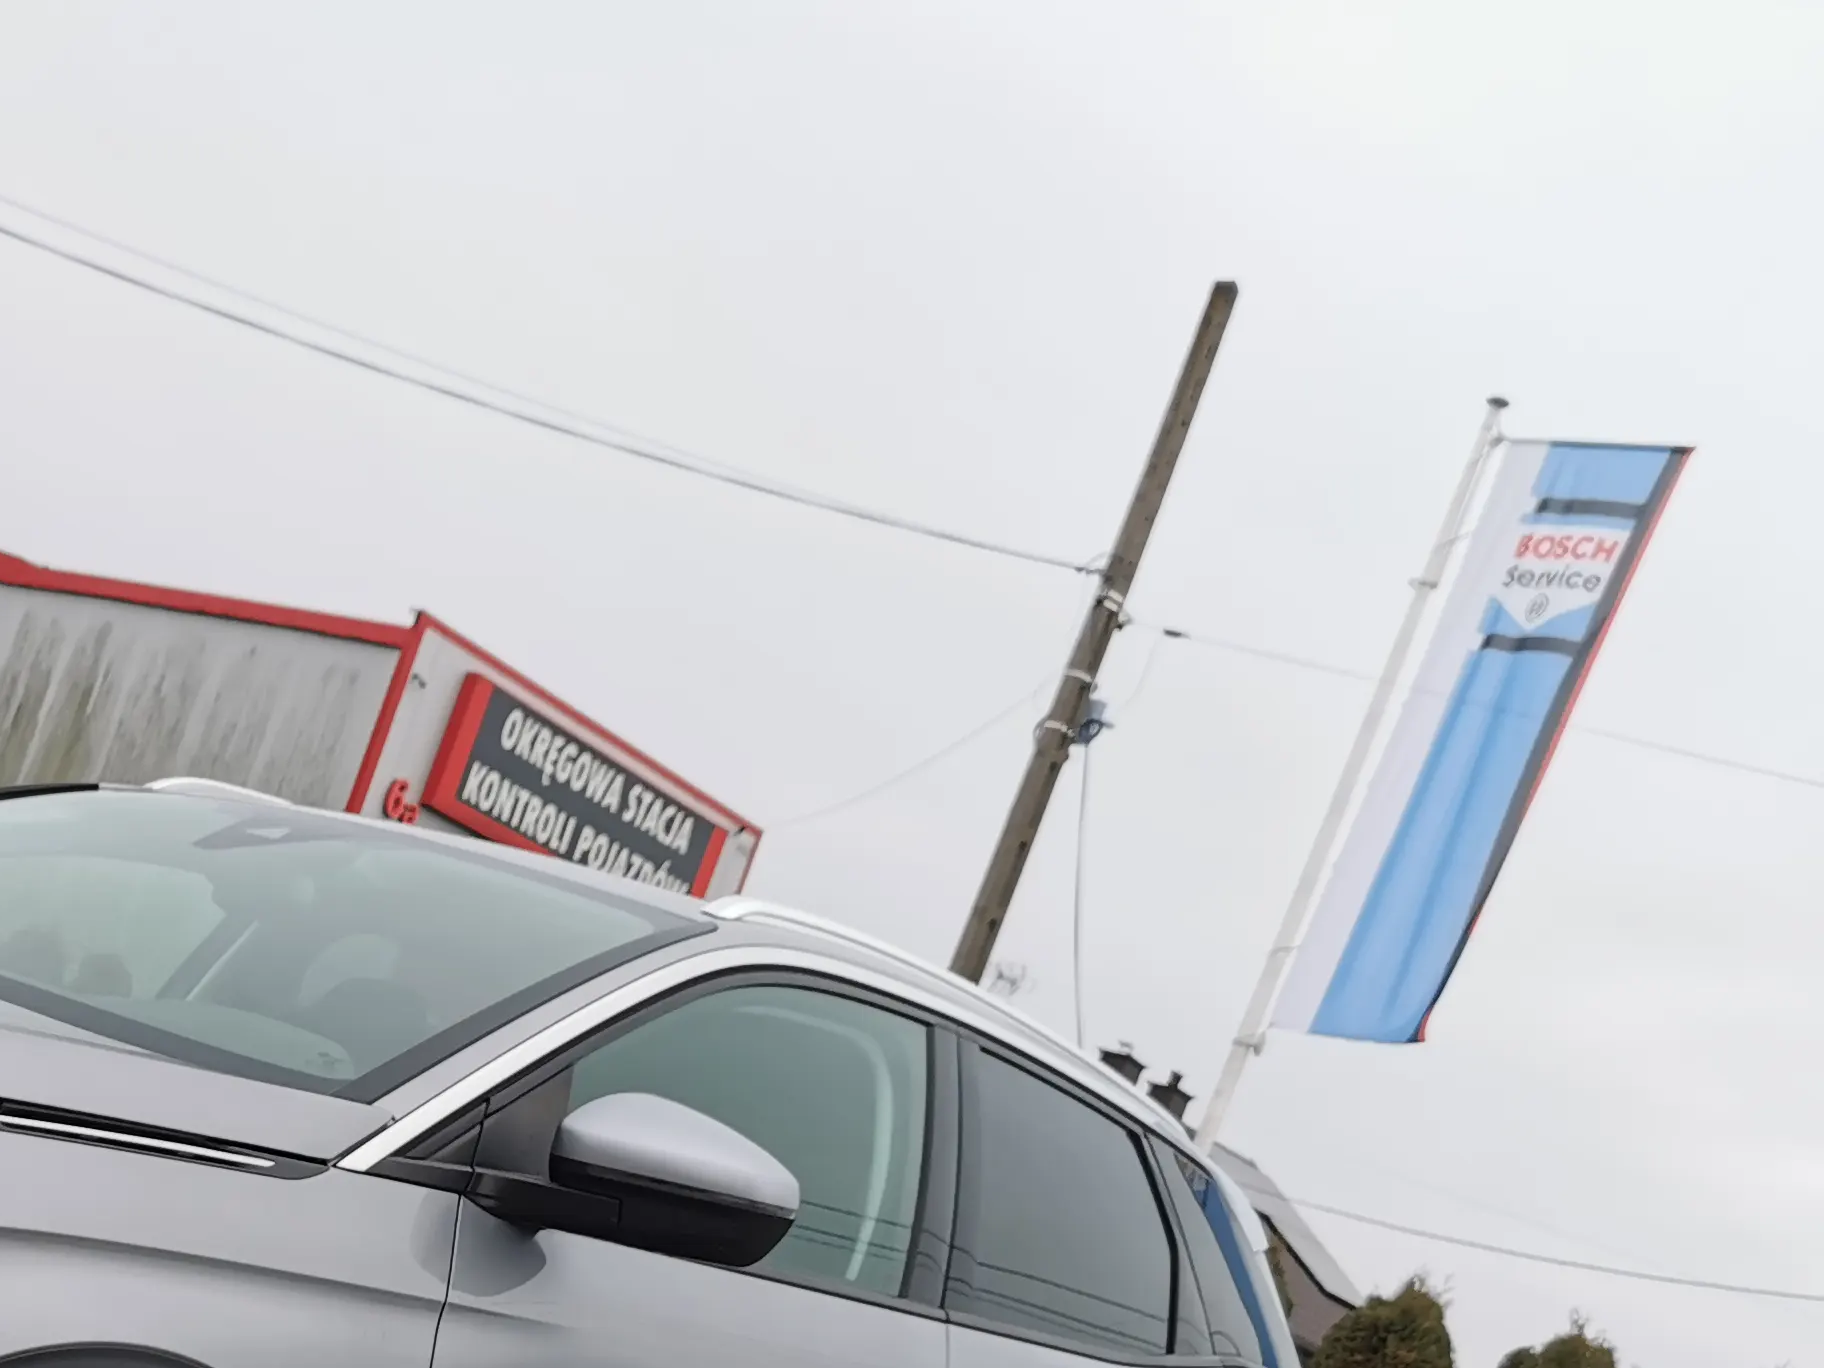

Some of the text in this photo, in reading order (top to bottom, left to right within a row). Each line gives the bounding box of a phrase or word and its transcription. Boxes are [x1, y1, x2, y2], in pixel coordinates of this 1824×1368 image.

[1502, 564, 1601, 593] Service
[1514, 533, 1619, 563] BOSCH
[461, 760, 578, 855] KONTROLI
[501, 707, 695, 855] OKRĘGOWA STACJA
